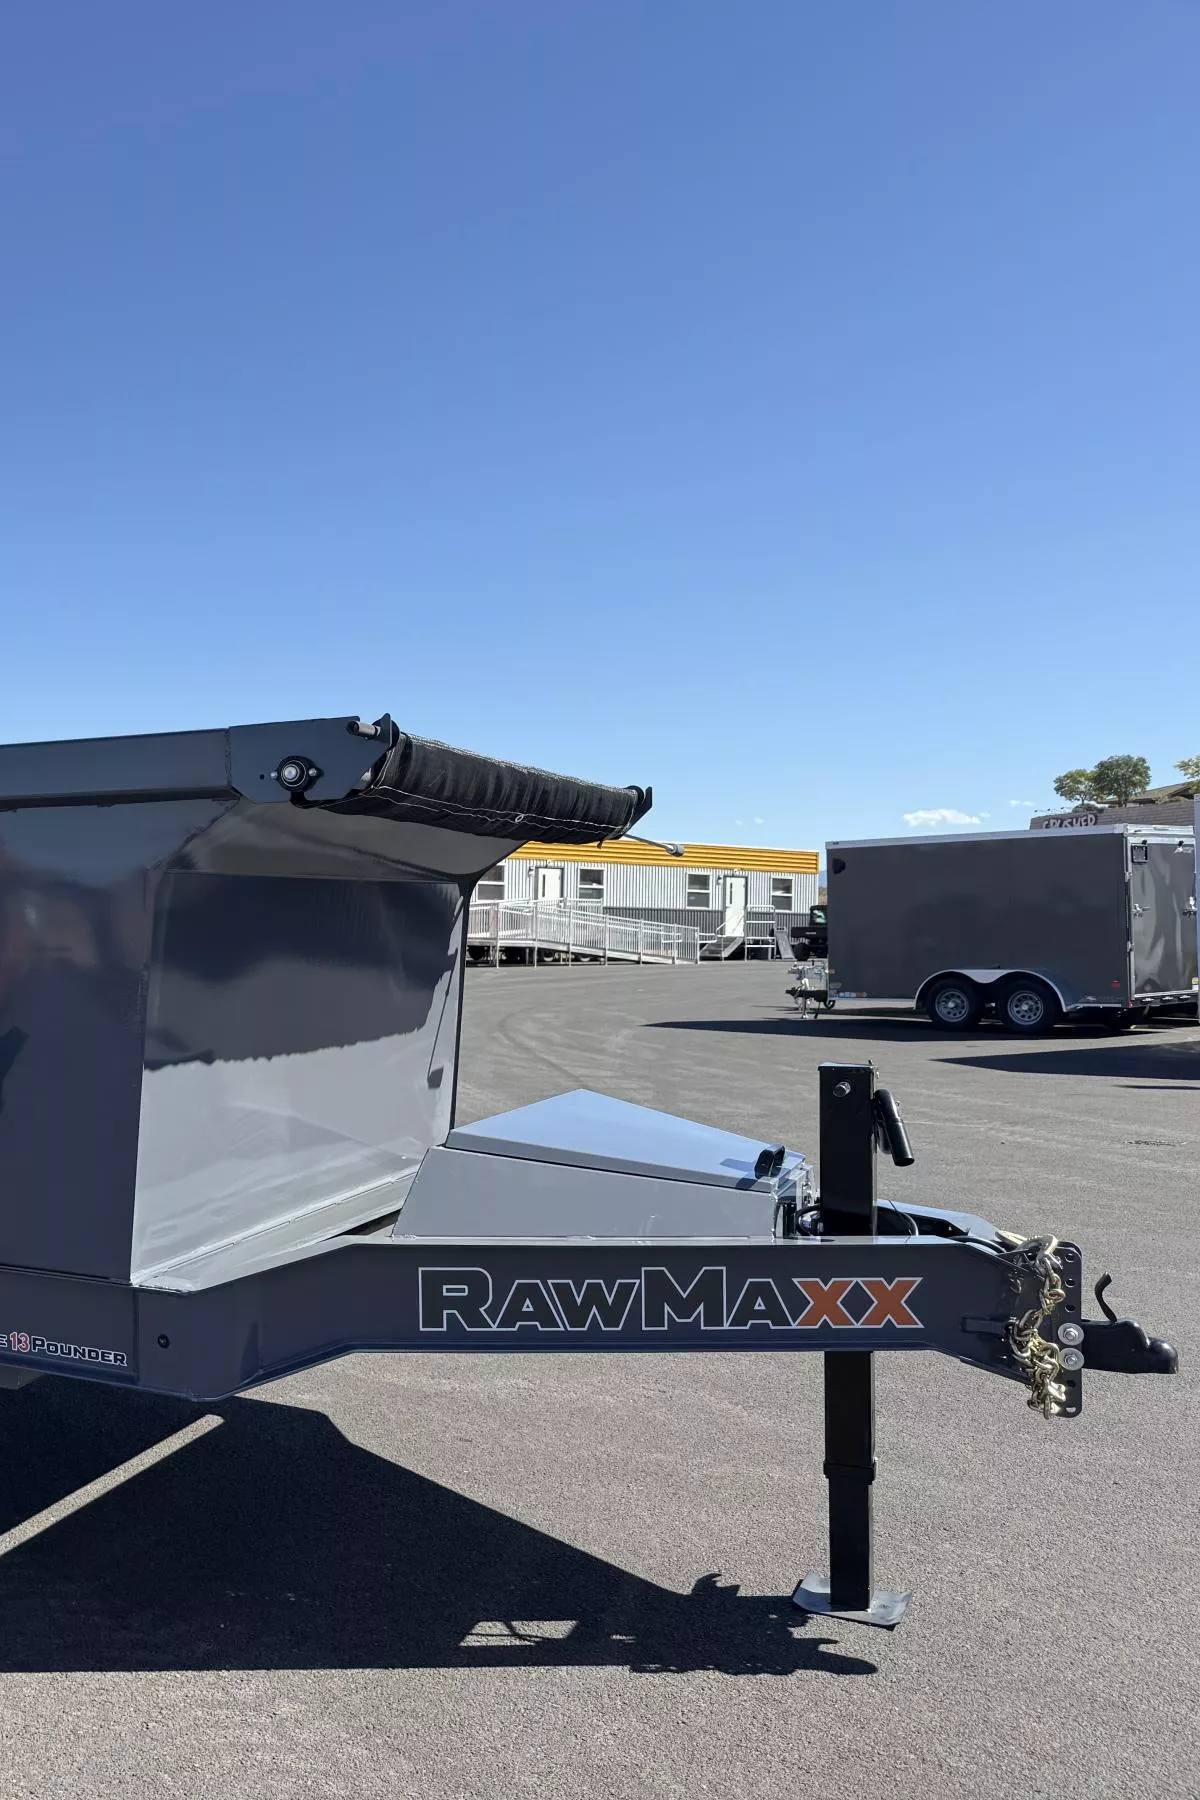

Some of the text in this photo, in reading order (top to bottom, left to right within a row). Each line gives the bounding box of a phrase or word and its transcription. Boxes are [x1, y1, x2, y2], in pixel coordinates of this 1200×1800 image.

[418, 1266, 924, 1331] RAWMAXX
[9, 1331, 31, 1353] 13
[31, 1335, 128, 1367] POUNDER
